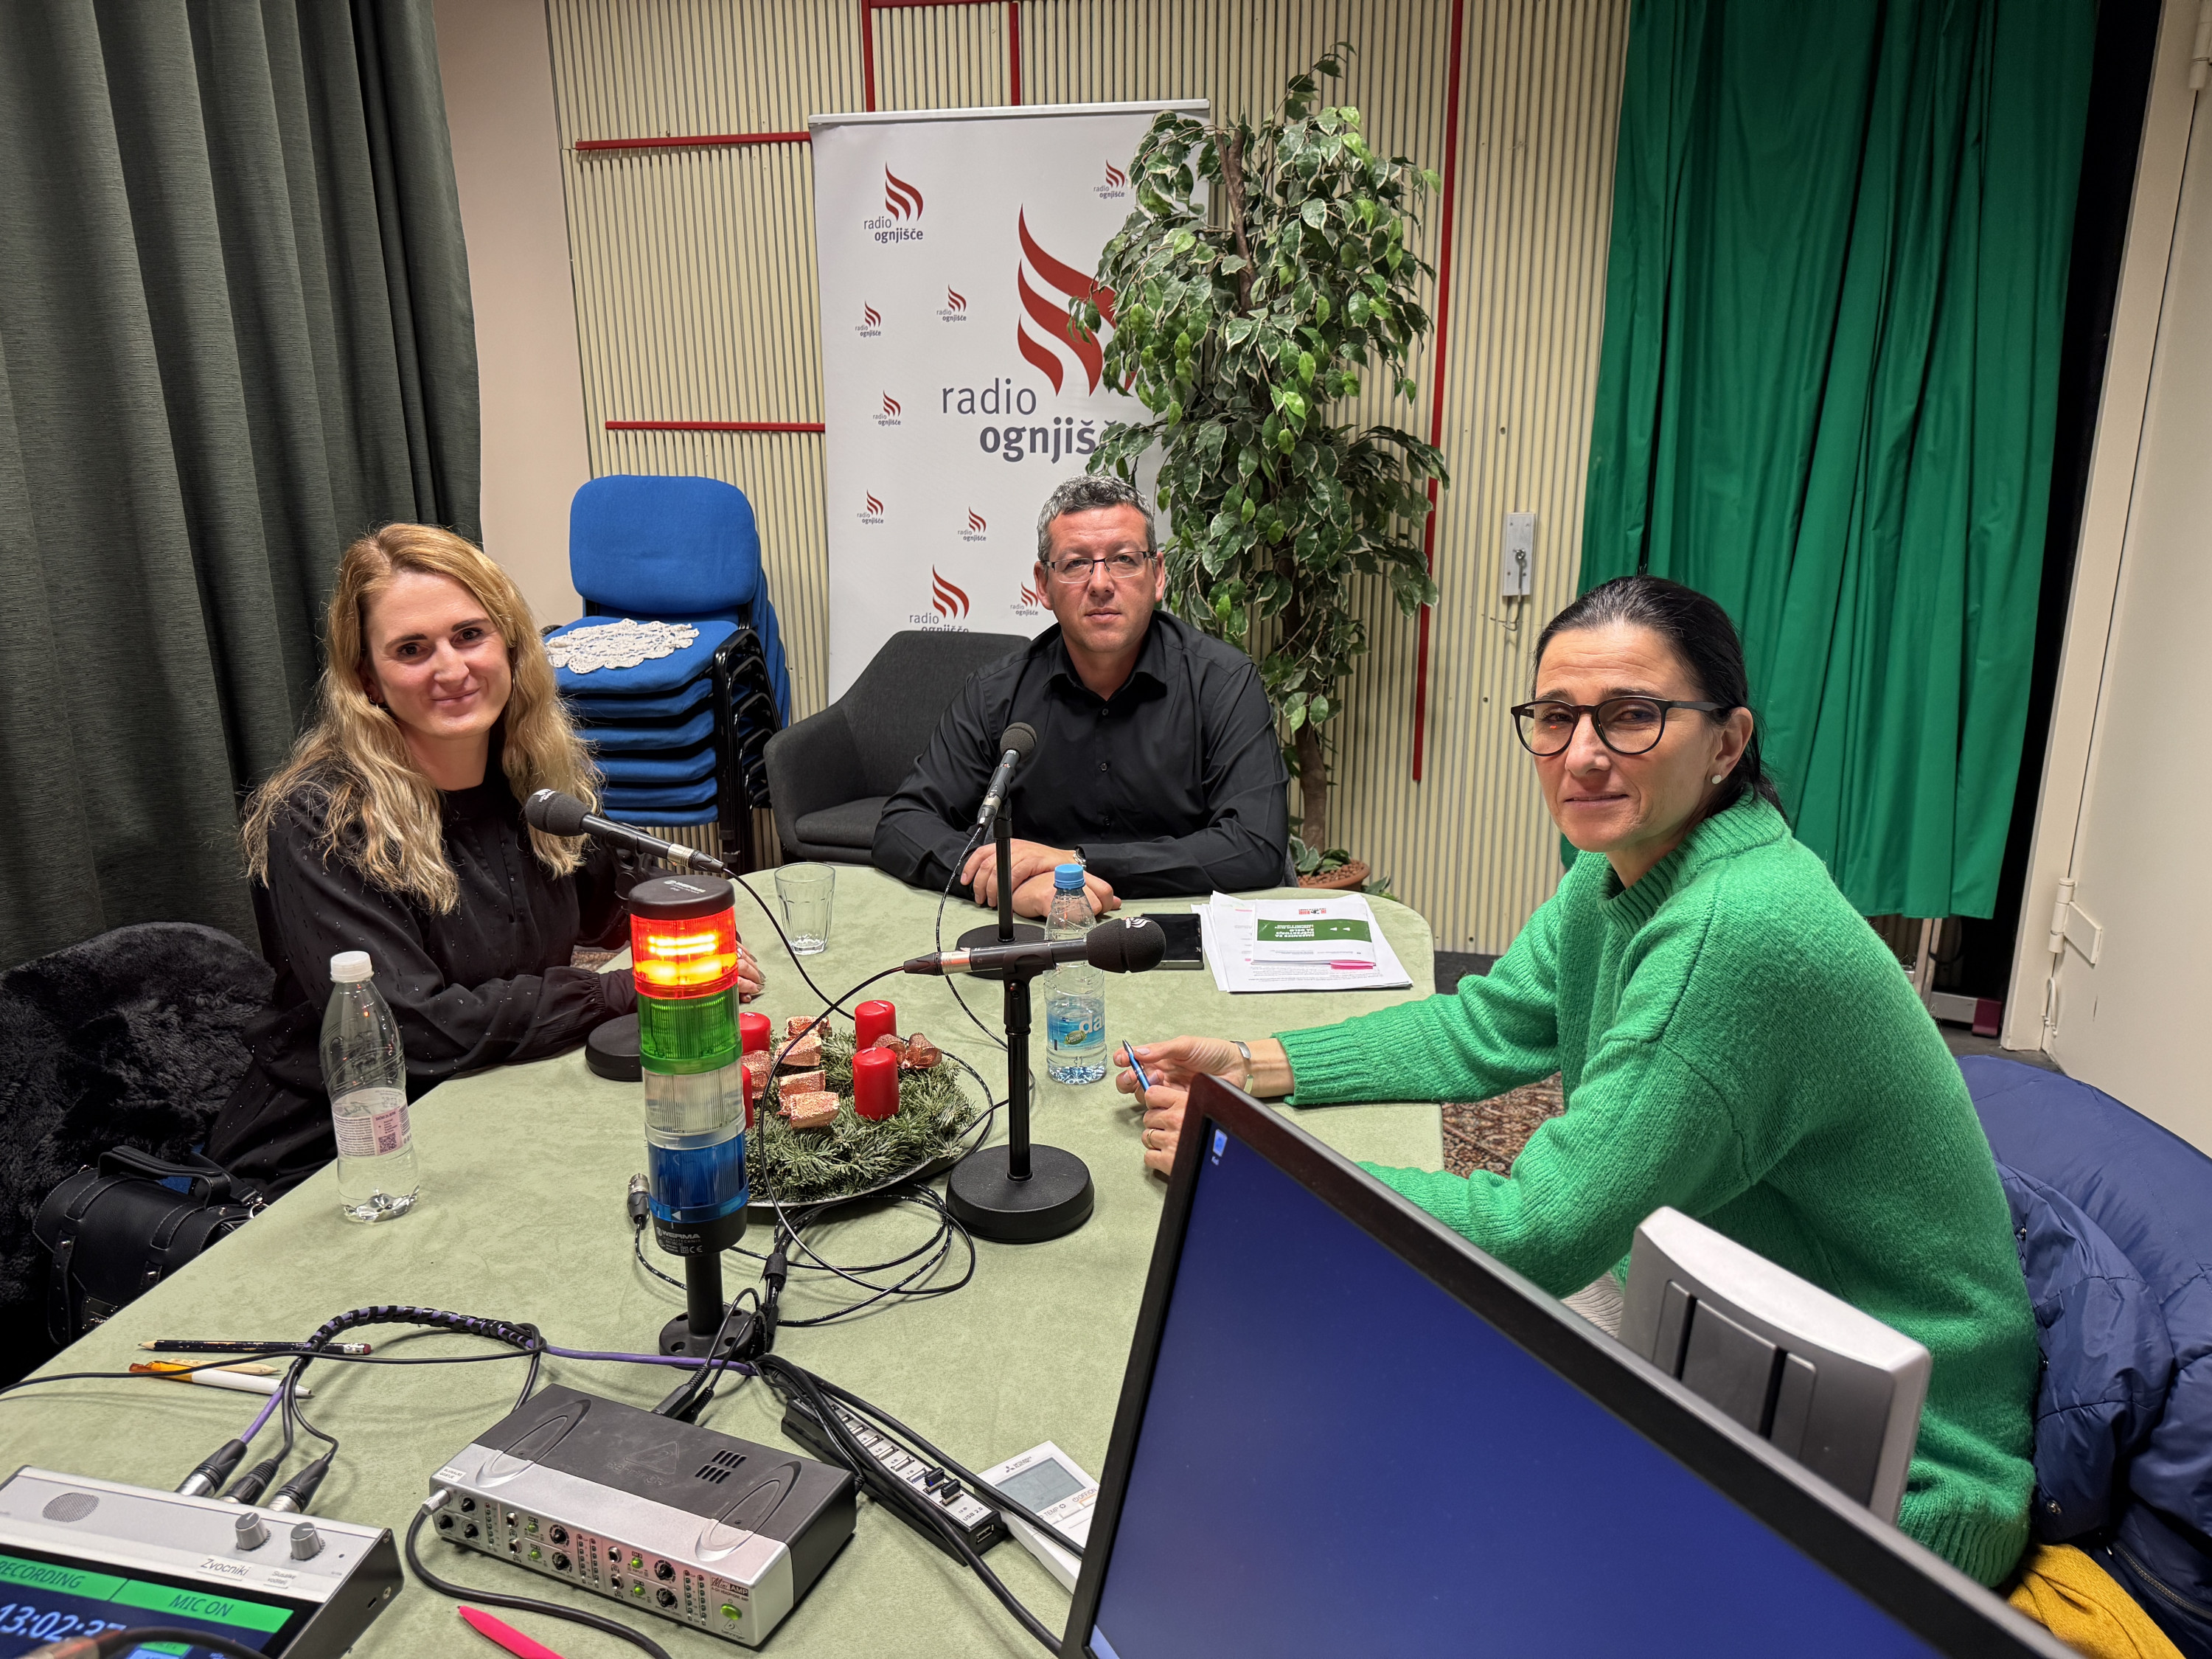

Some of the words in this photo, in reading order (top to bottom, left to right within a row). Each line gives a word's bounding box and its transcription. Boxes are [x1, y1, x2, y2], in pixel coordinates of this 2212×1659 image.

[863, 215, 891, 230] radio
[874, 227, 923, 244] ognjišče
[942, 378, 1037, 415] radio
[979, 417, 1117, 465] ognjiš
[909, 612, 939, 625] radio
[661, 1229, 700, 1239] WERMA
[1077, 1487, 1097, 1500] OFF/ON
[962, 1512, 975, 1522] USB
[1043, 1506, 1059, 1517] TEMP
[201, 1558, 251, 1576] Zvocniki
[711, 1577, 728, 1589] Mini
[731, 1585, 748, 1596] AMP
[168, 1594, 207, 1613] MIC
[204, 1601, 234, 1618] ON
